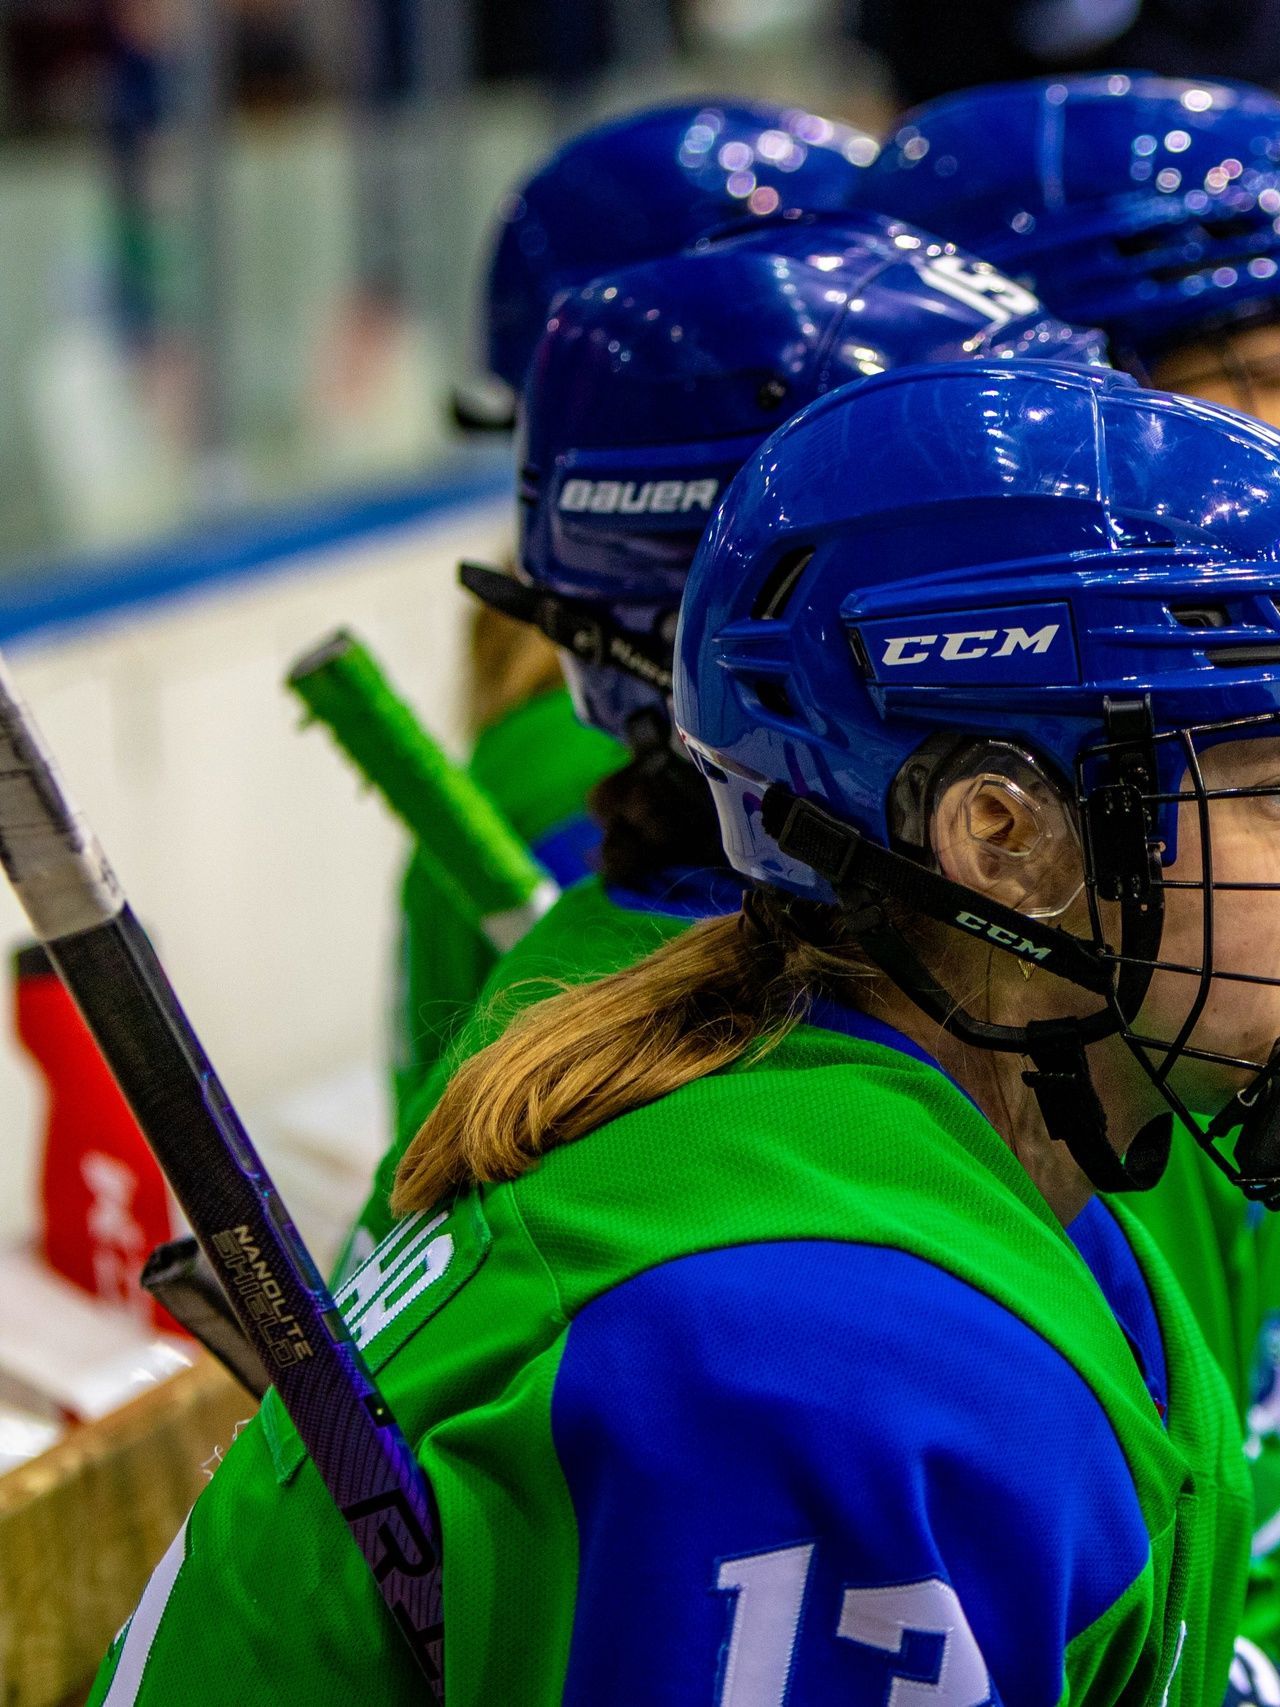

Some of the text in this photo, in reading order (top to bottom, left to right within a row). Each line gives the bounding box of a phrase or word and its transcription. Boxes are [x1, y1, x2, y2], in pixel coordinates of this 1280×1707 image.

[881, 624, 1060, 666] CCM
[955, 910, 1052, 961] CCM
[211, 1229, 298, 1368] SHIELD
[233, 1225, 314, 1360] NANOLITE
